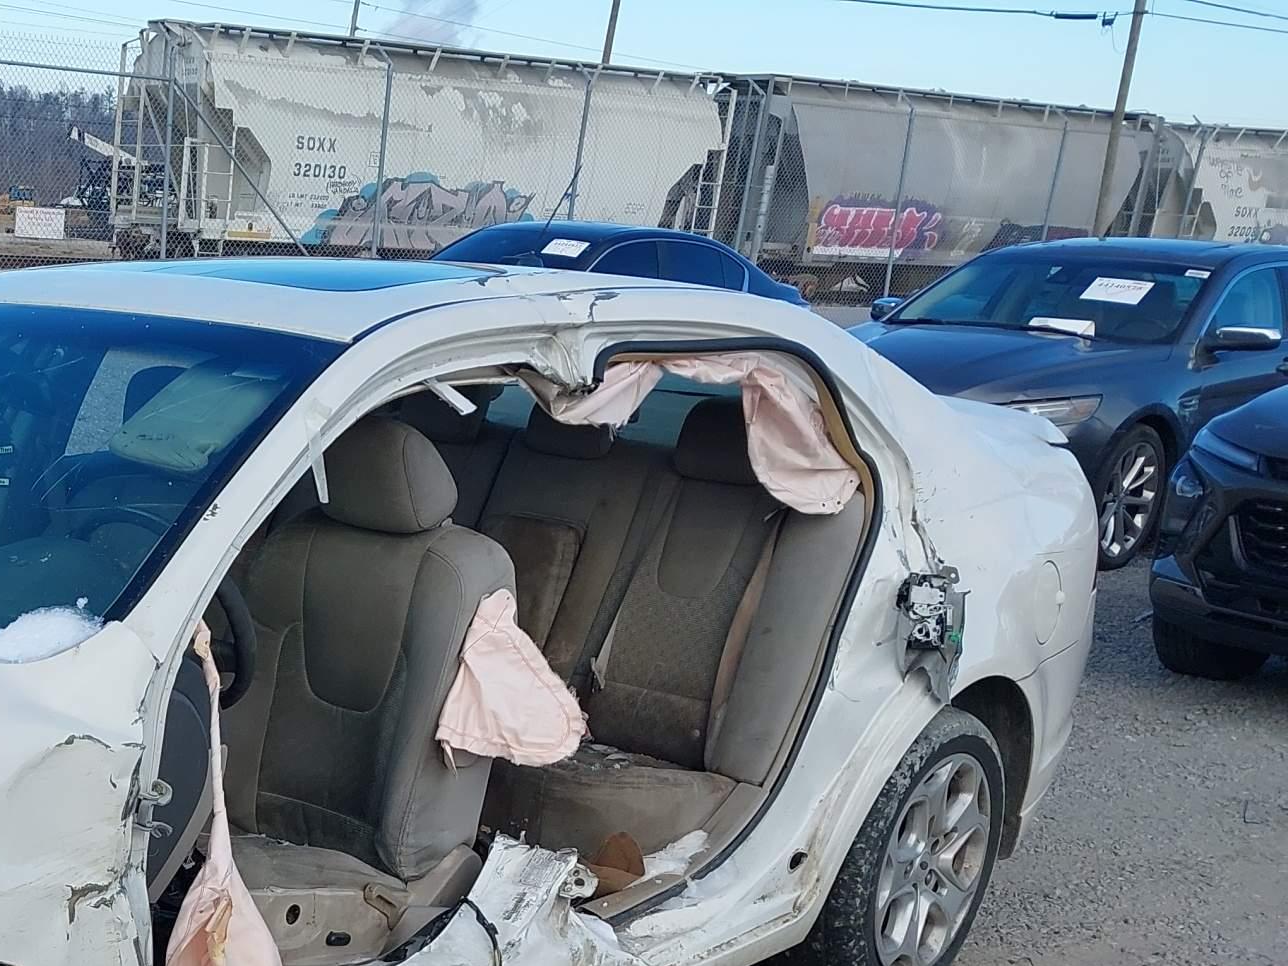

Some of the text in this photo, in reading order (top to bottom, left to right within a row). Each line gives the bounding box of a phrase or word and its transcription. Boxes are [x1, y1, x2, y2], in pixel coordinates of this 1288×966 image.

[296, 135, 337, 153] SOXX
[293, 162, 347, 179] 320130
[1234, 206, 1259, 218] SOXX
